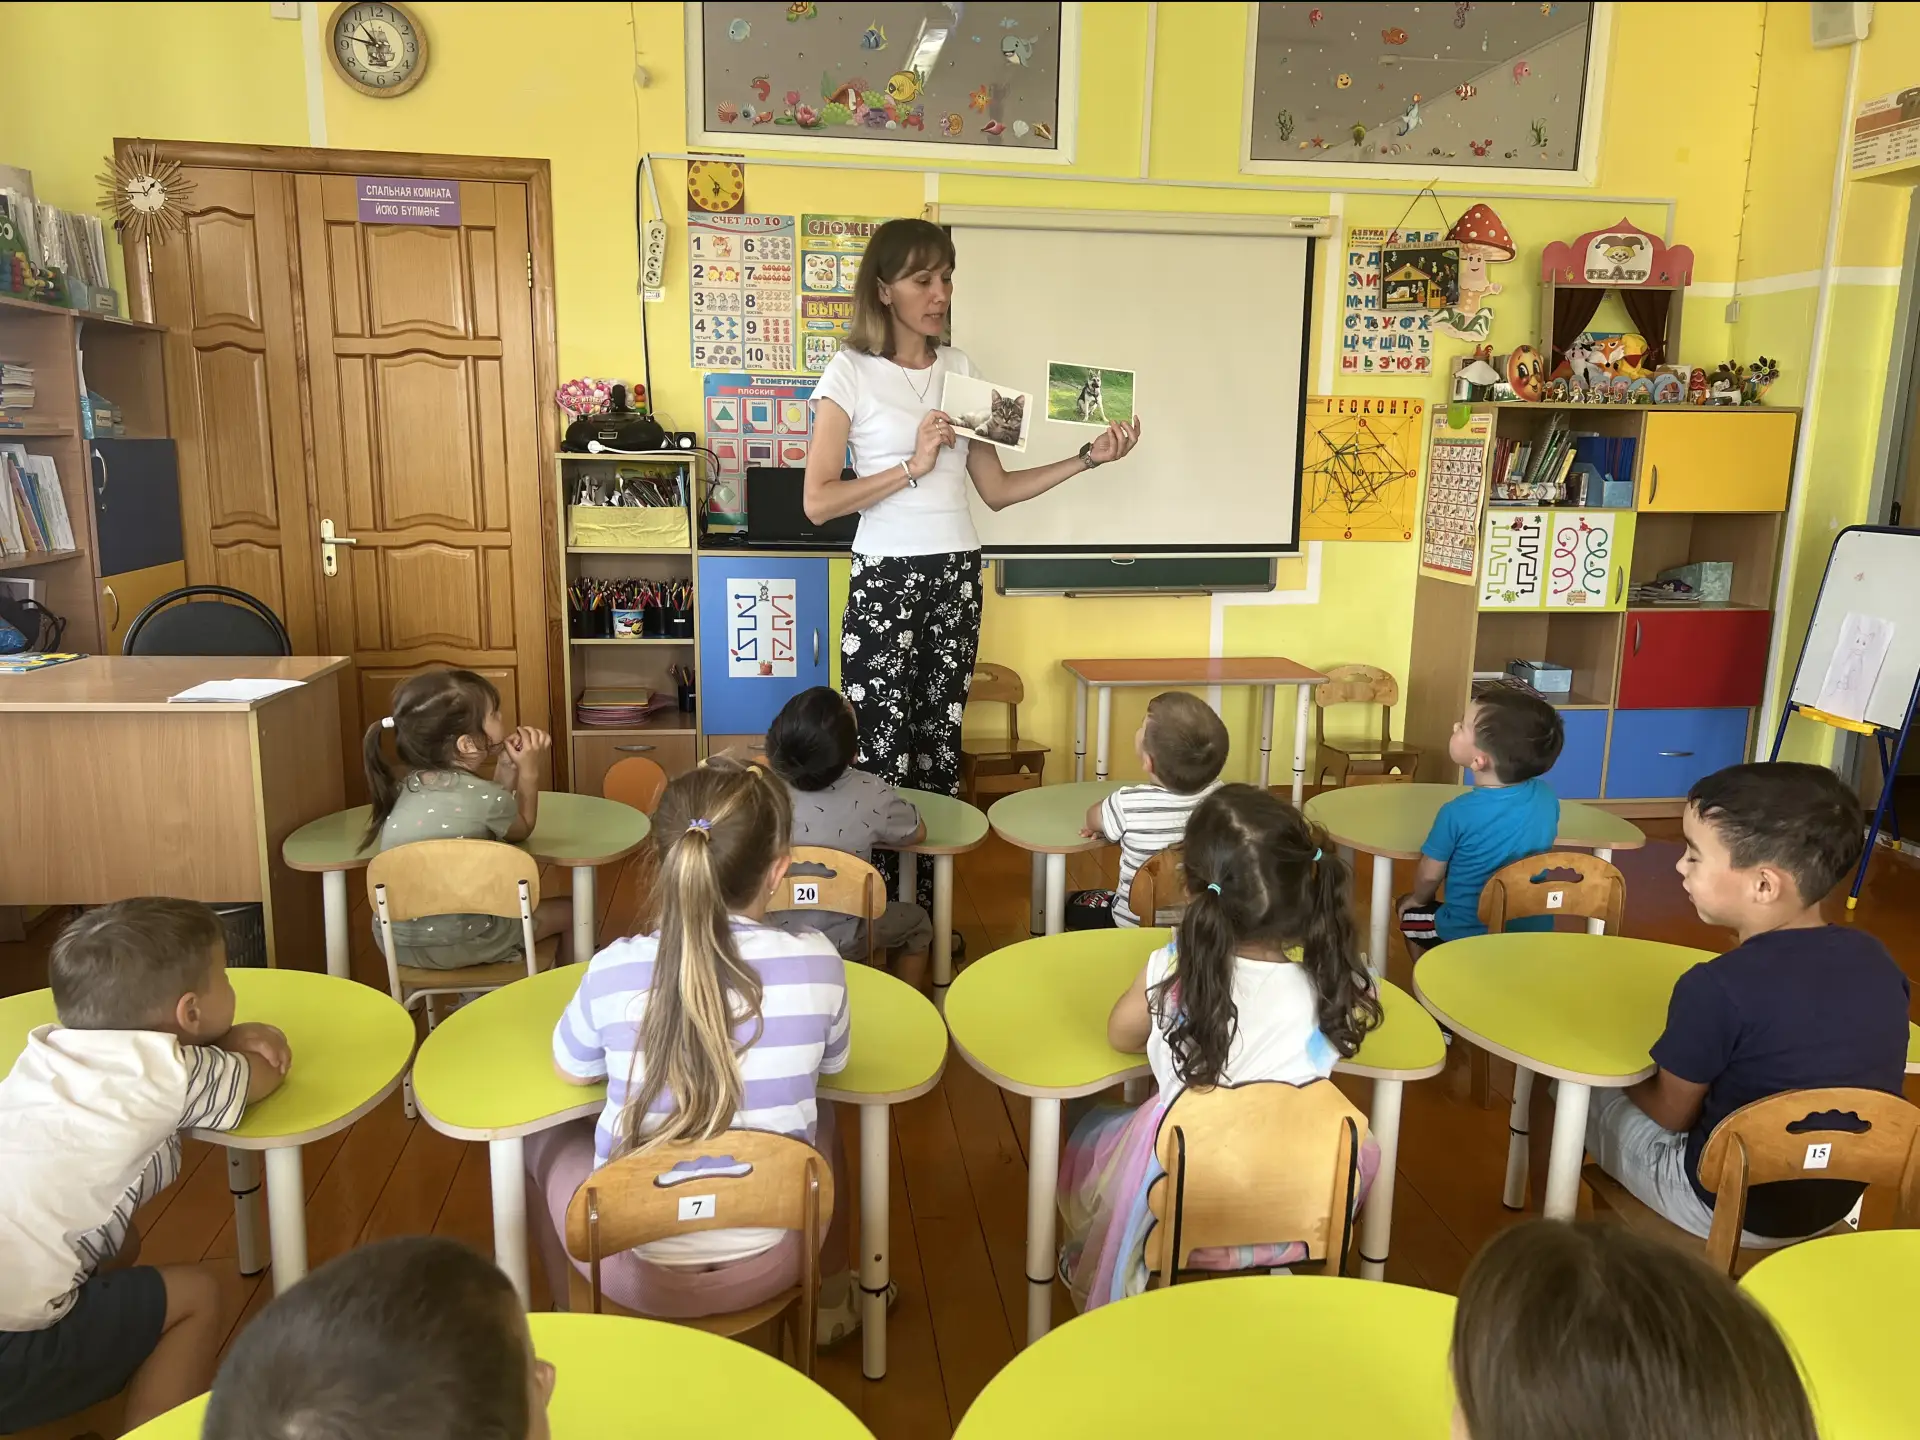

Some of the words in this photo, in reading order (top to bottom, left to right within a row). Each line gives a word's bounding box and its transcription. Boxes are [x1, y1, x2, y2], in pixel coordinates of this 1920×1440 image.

[369, 6, 383, 18] 12
[390, 11, 395, 22] 1
[343, 23, 355, 33] 10
[400, 25, 409, 35] 2
[340, 39, 350, 50] 9
[406, 42, 415, 53] 3
[346, 57, 356, 67] 8
[402, 60, 411, 70] 4
[359, 70, 368, 80] 7
[376, 75, 386, 86] 6
[392, 71, 402, 82] 5
[366, 185, 412, 197] СПАЛЬНАЯ
[413, 187, 452, 198] КОМНАТА
[711, 216, 742, 225] СЧЕТ
[744, 217, 761, 226] ДО
[764, 217, 781, 226] 10
[1351, 229, 1384, 237] АЗБУКА
[693, 236, 701, 250] 1
[744, 238, 755, 252] 6
[693, 264, 704, 279] 2
[744, 266, 756, 280] 7
[1585, 265, 1647, 280] ТЕАТР
[694, 292, 704, 306] 3
[745, 294, 756, 308] 8
[1346, 295, 1358, 307] М
[1364, 295, 1376, 308] Н
[695, 318, 706, 332] 4
[746, 320, 757, 334] 9
[695, 346, 706, 360] 5
[746, 348, 764, 361] 10
[1342, 356, 1358, 368] Ы
[737, 387, 775, 396] ПЛОСКИЕ
[1326, 398, 1409, 415] ГЕОКОНТ
[797, 887, 815, 901] 20
[1811, 1147, 1827, 1158] 15
[691, 1201, 702, 1215] 7
